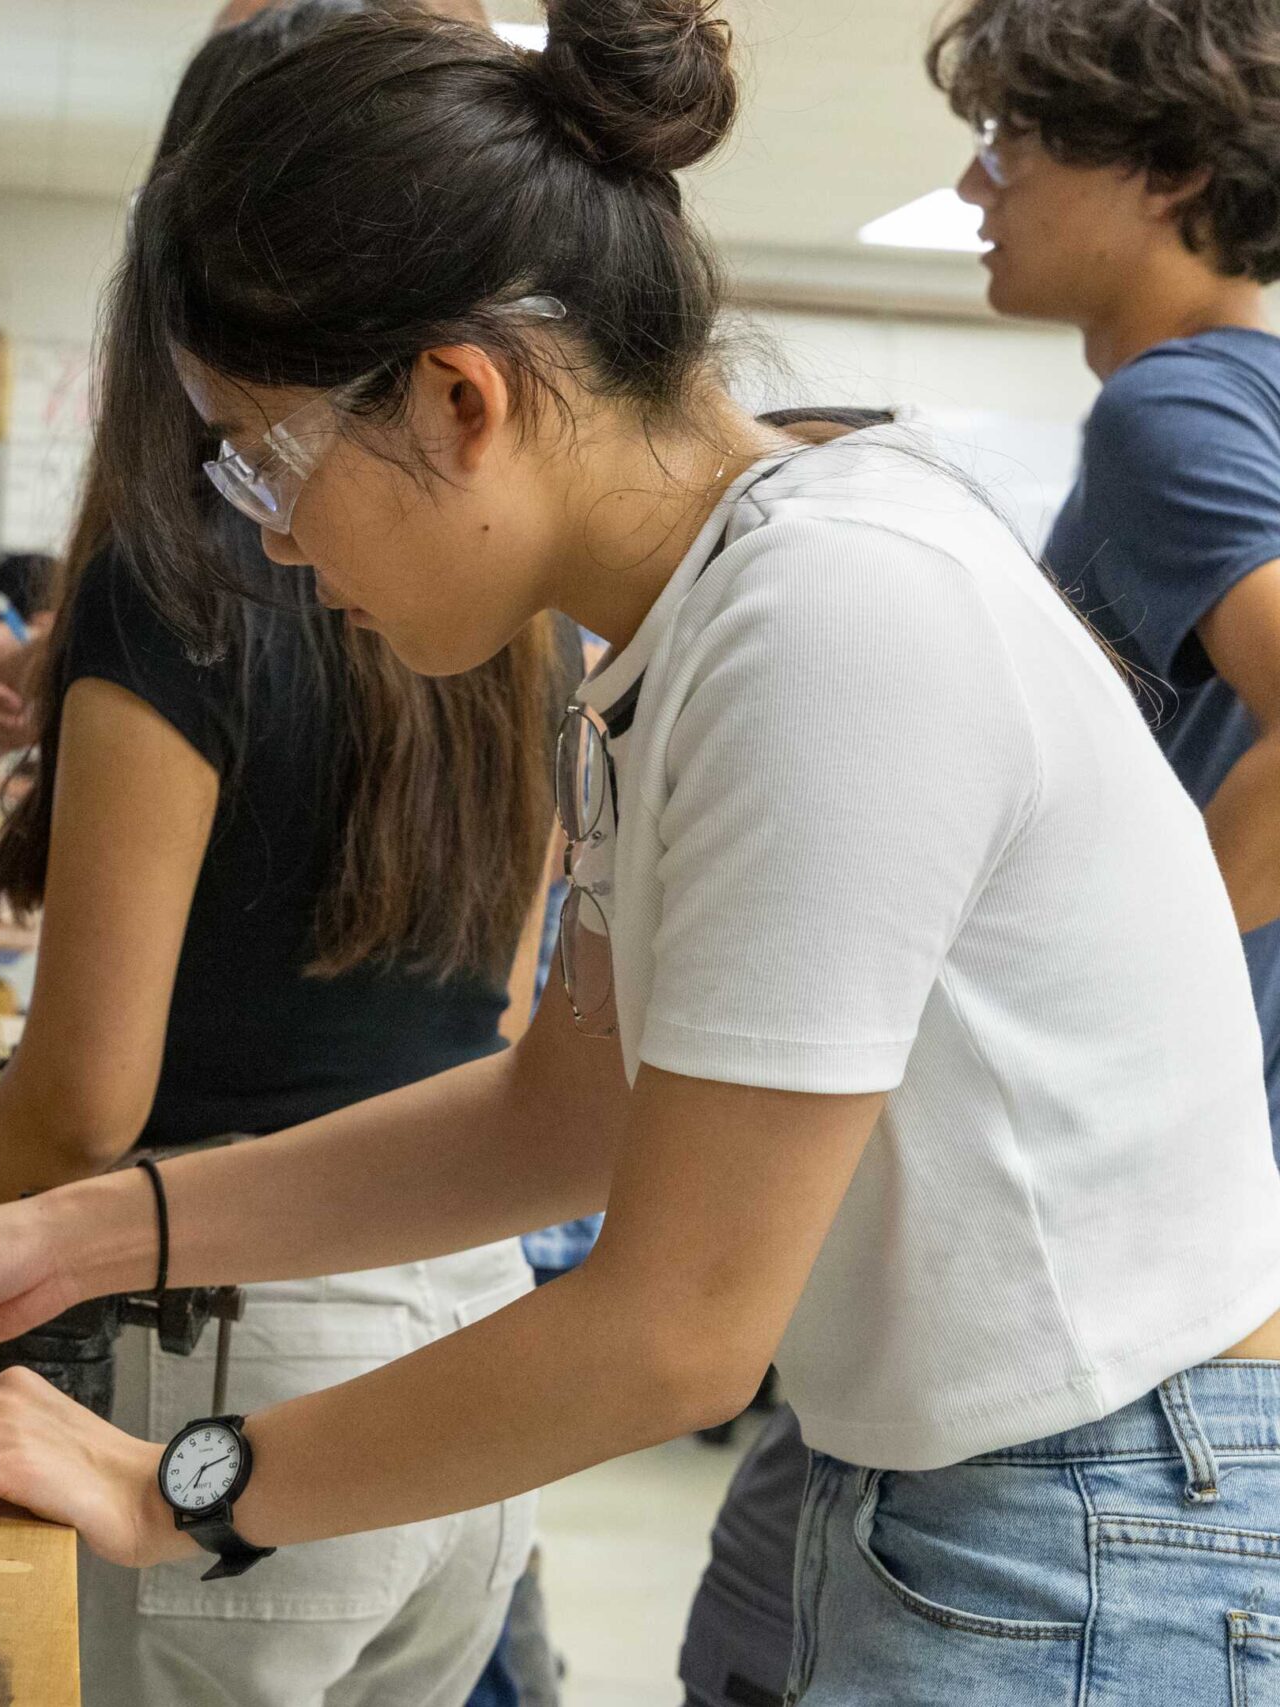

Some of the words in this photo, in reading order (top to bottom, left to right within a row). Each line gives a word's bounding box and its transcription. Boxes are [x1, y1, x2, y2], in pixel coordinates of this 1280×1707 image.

[204, 1431, 211, 1441] 6
[218, 1435, 225, 1444] 7
[189, 1438, 197, 1447] 5
[227, 1445, 236, 1454] 8
[229, 1461, 238, 1469] 9
[170, 1468, 180, 1476] 3
[222, 1477, 233, 1488] 10
[173, 1483, 182, 1492] 2
[182, 1493, 189, 1502] 1
[210, 1490, 220, 1500] 11
[195, 1495, 205, 1506] 12
